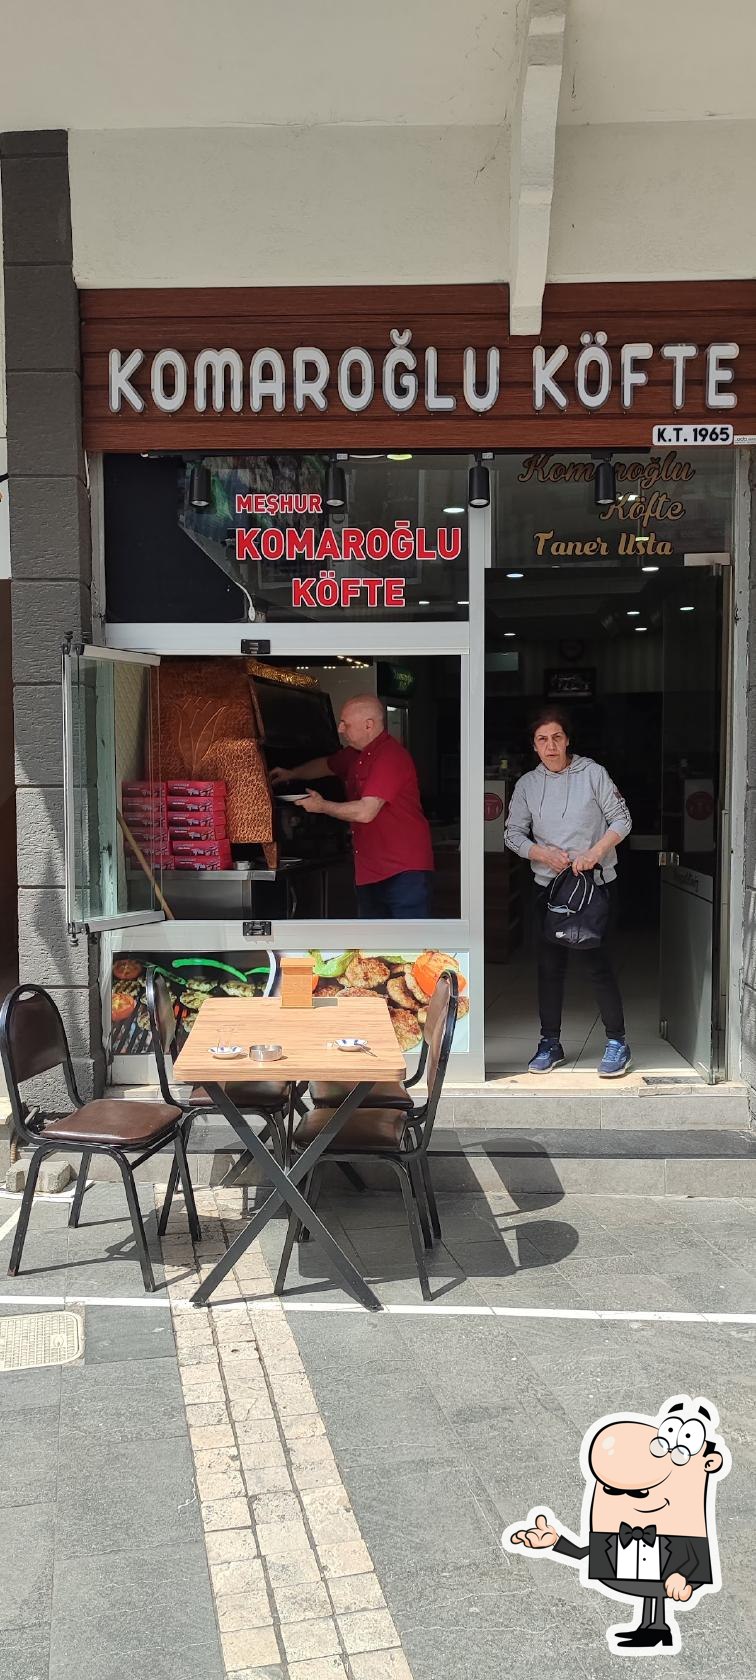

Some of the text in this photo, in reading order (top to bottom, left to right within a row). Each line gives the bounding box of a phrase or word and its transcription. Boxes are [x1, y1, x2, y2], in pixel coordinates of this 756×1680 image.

[109, 328, 740, 412] KOMAROĞLU KÖFTE
[657, 427, 730, 442] K.T. 1965
[517, 451, 696, 489] Komroğlu
[235, 494, 323, 515] MEŞHUR
[599, 491, 686, 527] Köfte
[533, 530, 673, 556] Taner Usta
[292, 570, 406, 608] KÖFTE
